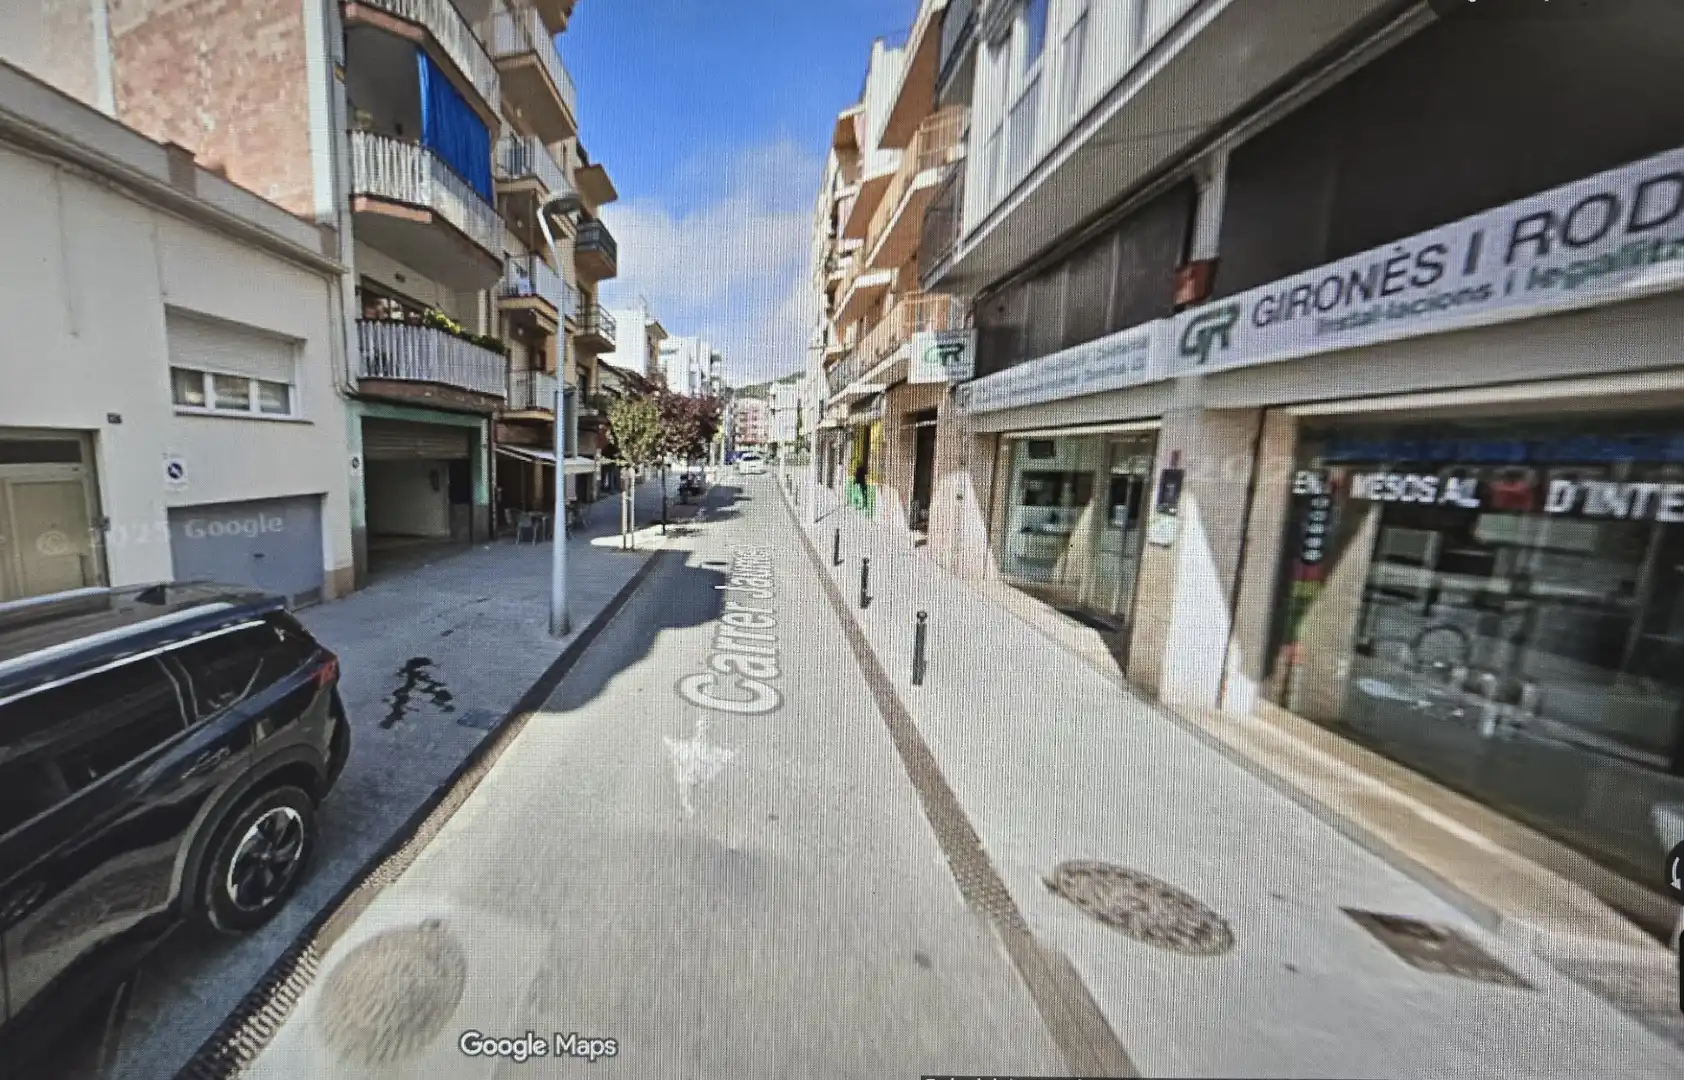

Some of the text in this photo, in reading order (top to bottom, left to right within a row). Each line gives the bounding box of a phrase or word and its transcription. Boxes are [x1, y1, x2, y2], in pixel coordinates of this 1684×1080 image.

[1252, 171, 1684, 328] GIRONÈS I ROD
